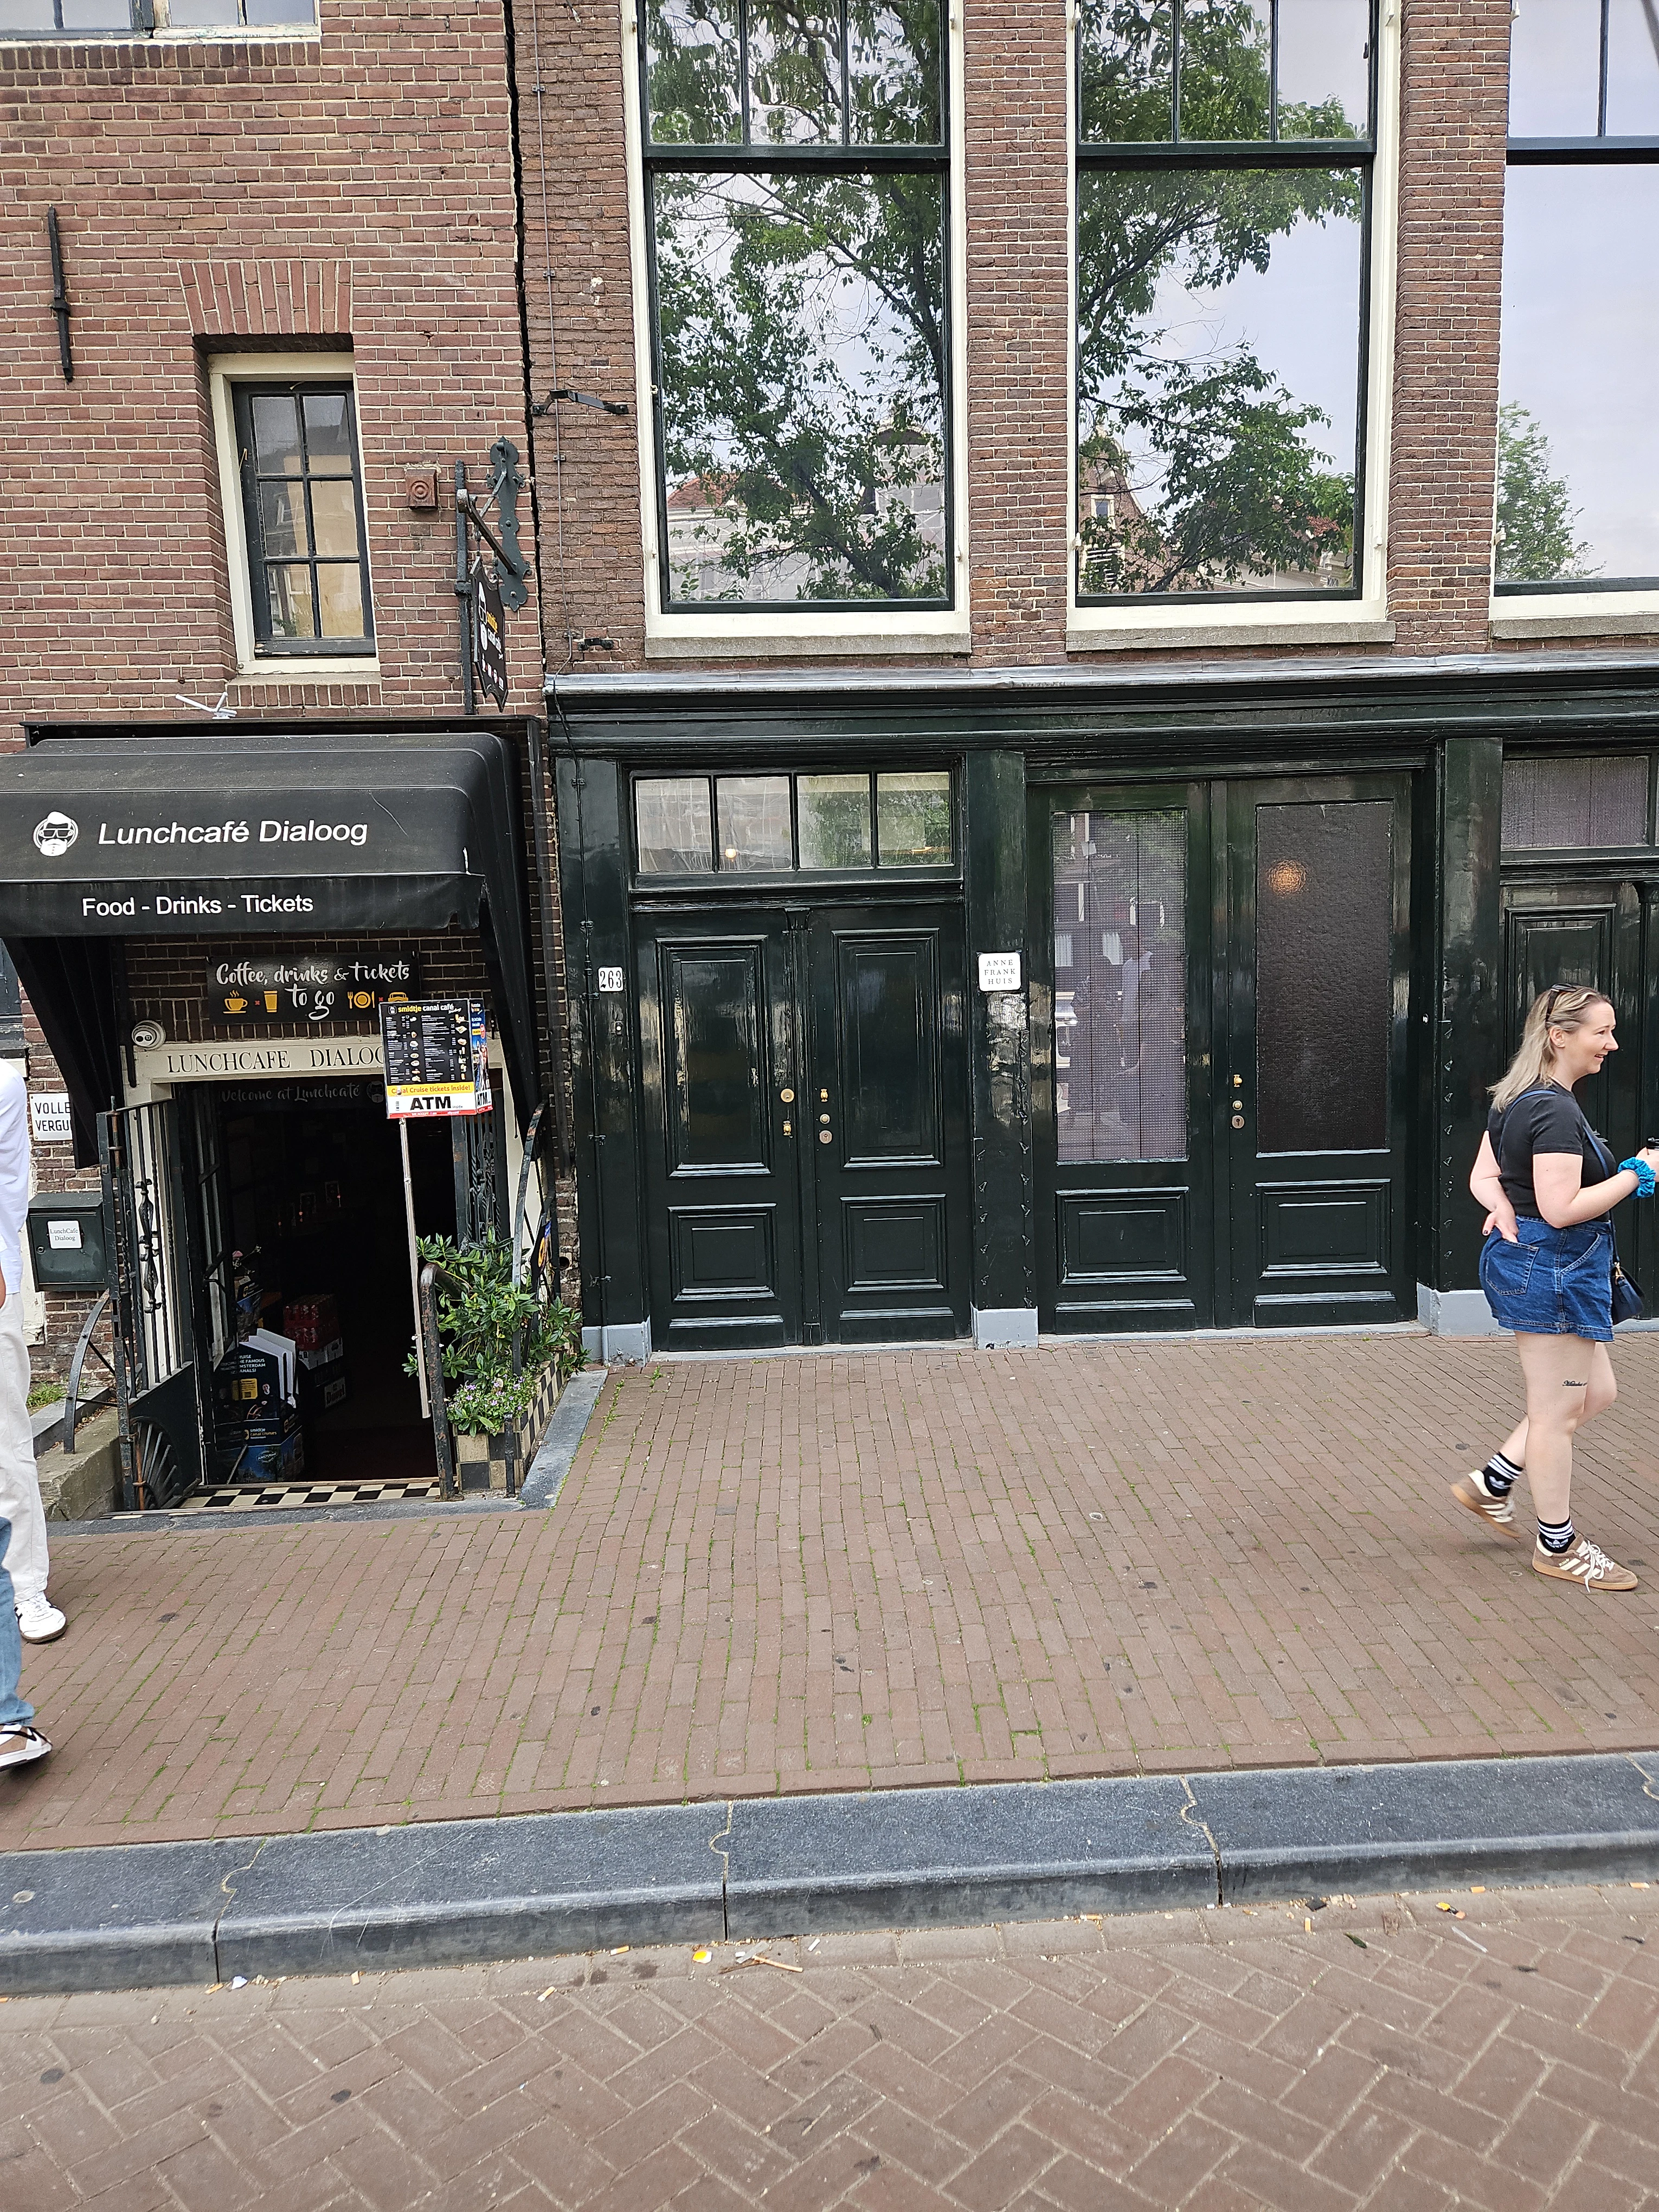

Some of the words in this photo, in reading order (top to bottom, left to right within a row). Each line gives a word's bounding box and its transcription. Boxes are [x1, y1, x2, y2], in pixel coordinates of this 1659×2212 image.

[98, 821, 249, 845] Lunchcafé
[259, 820, 368, 846] Dialoog
[82, 897, 135, 916] Food
[156, 896, 222, 915] Drinks
[241, 895, 313, 912] Tickets
[216, 961, 268, 987] Coffee,
[274, 964, 329, 985] drinks
[333, 968, 350, 981] &
[600, 970, 622, 989] 263
[284, 983, 307, 1008] to
[308, 991, 335, 1020] go
[167, 1050, 290, 1073] LUNCHCAFE
[277, 1086, 293, 1100] at
[477, 1092, 488, 1107] ATM
[34, 1102, 71, 1114] VOLLE
[409, 1096, 452, 1111] ATM
[35, 1120, 71, 1131] VERGU
